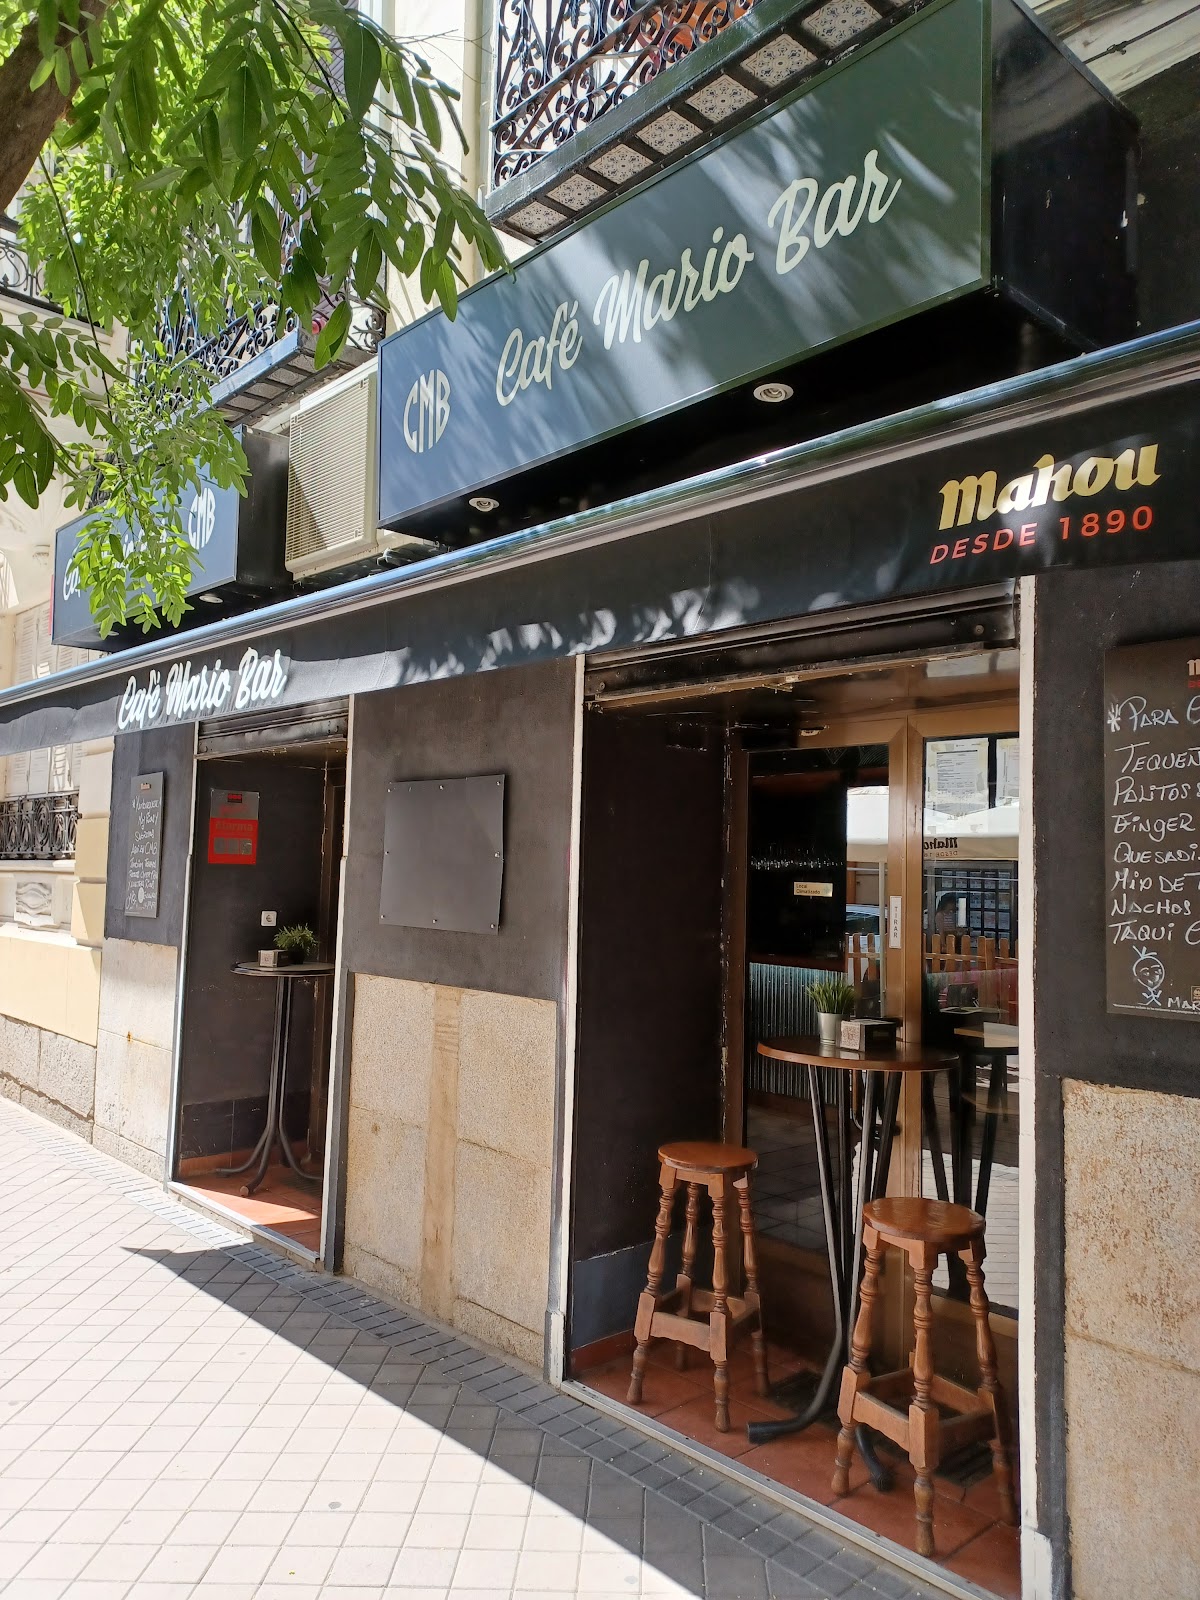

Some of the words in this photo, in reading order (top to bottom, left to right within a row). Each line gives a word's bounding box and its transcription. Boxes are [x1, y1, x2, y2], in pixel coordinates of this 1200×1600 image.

[496, 300, 583, 406] Café
[593, 226, 754, 350] Mario
[767, 149, 902, 275] Bar
[403, 369, 451, 453] CMB
[187, 487, 216, 550] CMB
[929, 522, 1038, 565] DESDE
[1059, 505, 1154, 540] 1890
[118, 669, 162, 730] Café
[165, 659, 231, 718] Mario
[235, 646, 287, 709] Bar
[1111, 893, 1191, 916] NACHOS
[1159, 875, 1185, 893] DE
